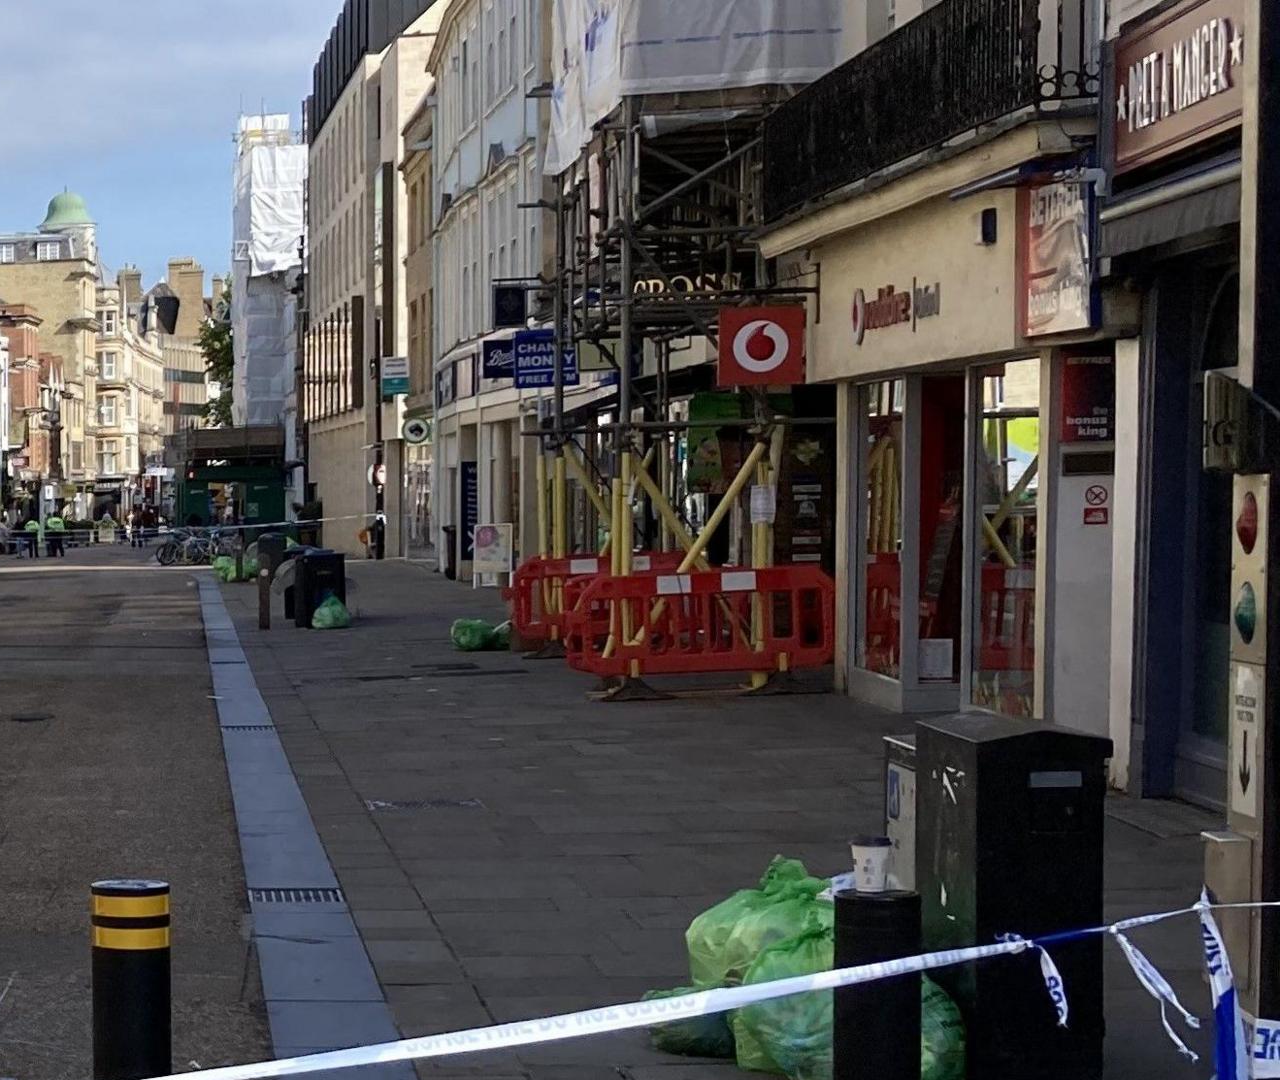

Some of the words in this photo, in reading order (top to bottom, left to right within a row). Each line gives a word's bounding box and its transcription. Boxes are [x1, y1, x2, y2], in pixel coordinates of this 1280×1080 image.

[1128, 51, 1157, 133] PRET
[1161, 51, 1171, 118] A
[1173, 18, 1229, 111] MANGER
[518, 353, 574, 368] MONY
[519, 374, 548, 384] FREE
[1066, 416, 1107, 425] bonus
[1078, 425, 1107, 437] king
